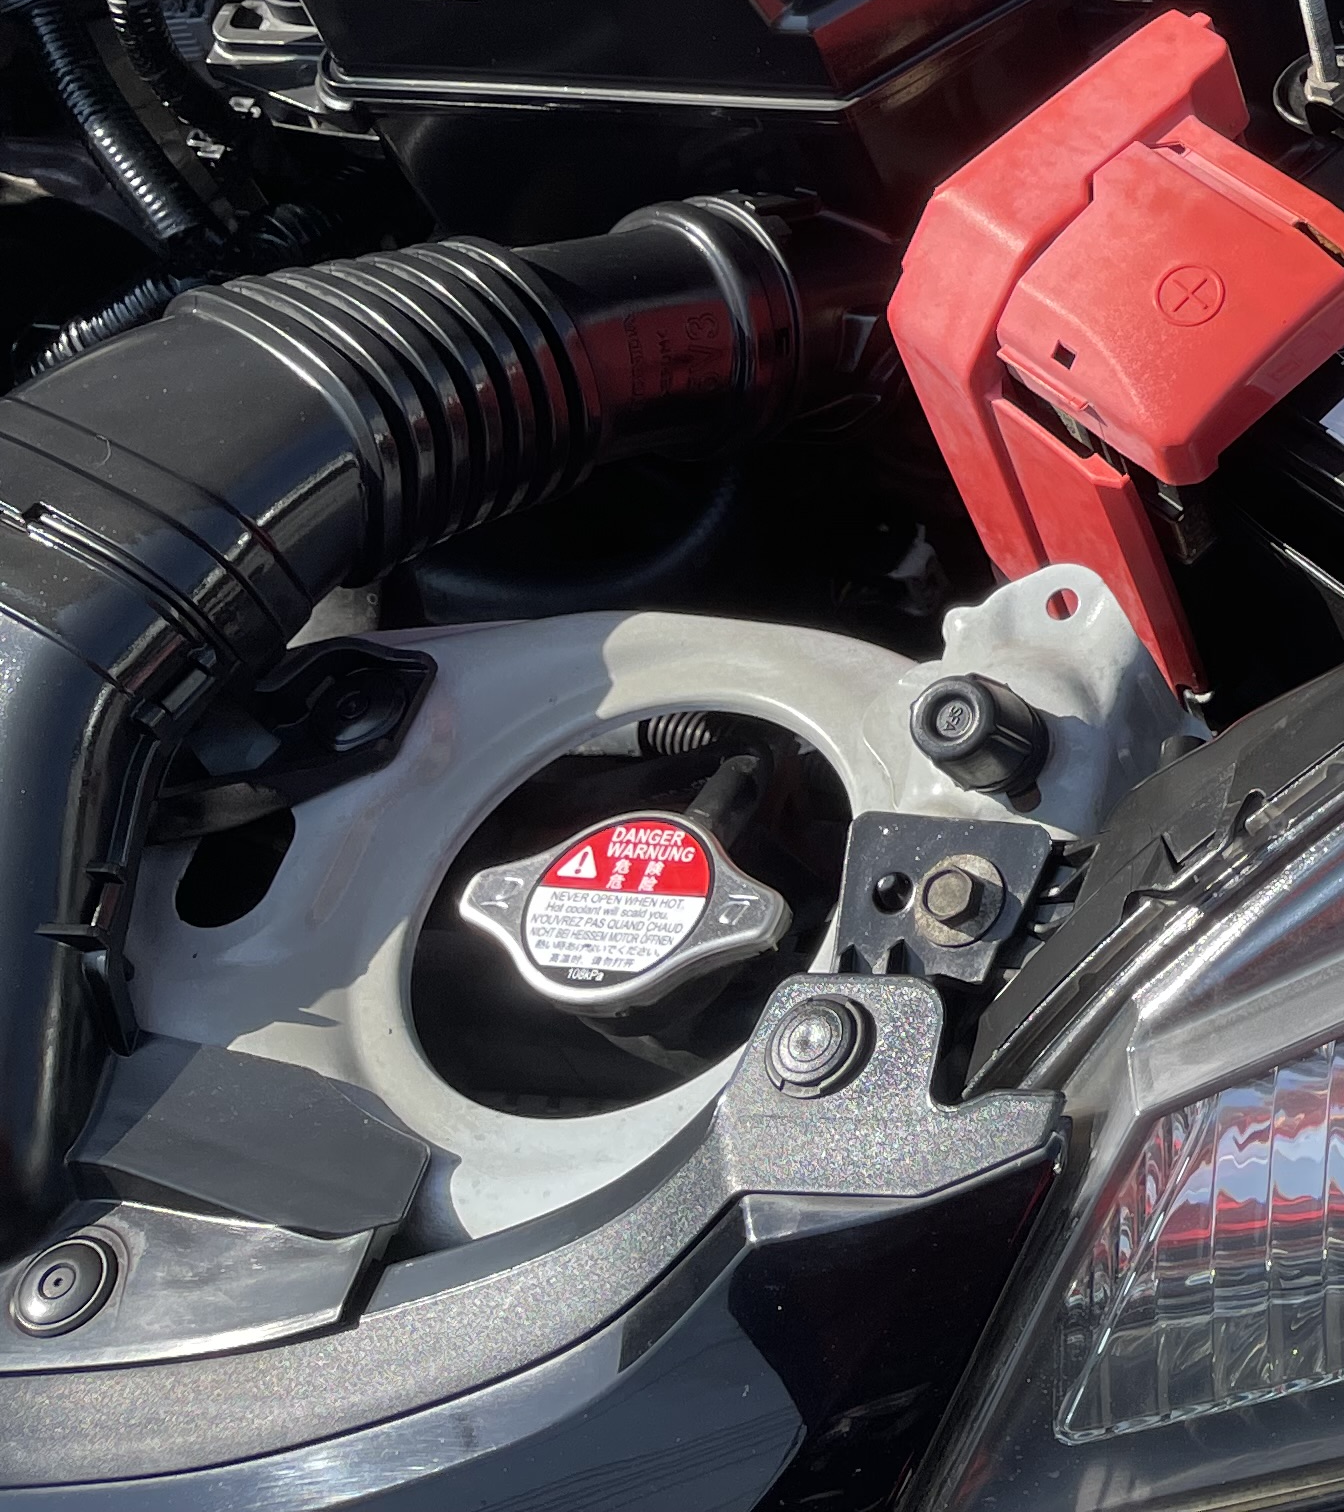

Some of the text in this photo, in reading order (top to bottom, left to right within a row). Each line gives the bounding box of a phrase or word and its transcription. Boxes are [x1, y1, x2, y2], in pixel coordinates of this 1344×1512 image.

[612, 827, 685, 846] DANGER
[606, 841, 696, 863] WARNUNG
[550, 891, 590, 903] NEVER
[591, 893, 622, 905] OPEN
[625, 895, 658, 908] WHEN
[545, 901, 669, 921] Hot coolant will scald you.
[530, 913, 584, 928] N'OUVREZ
[584, 917, 607, 929] PAS
[607, 919, 645, 932] QUAND
[530, 926, 557, 938] NICHT
[555, 928, 571, 939] BEI
[570, 929, 609, 942] HEISSEM
[607, 932, 639, 944] MOTOR
[567, 968, 605, 982] 108kPa
